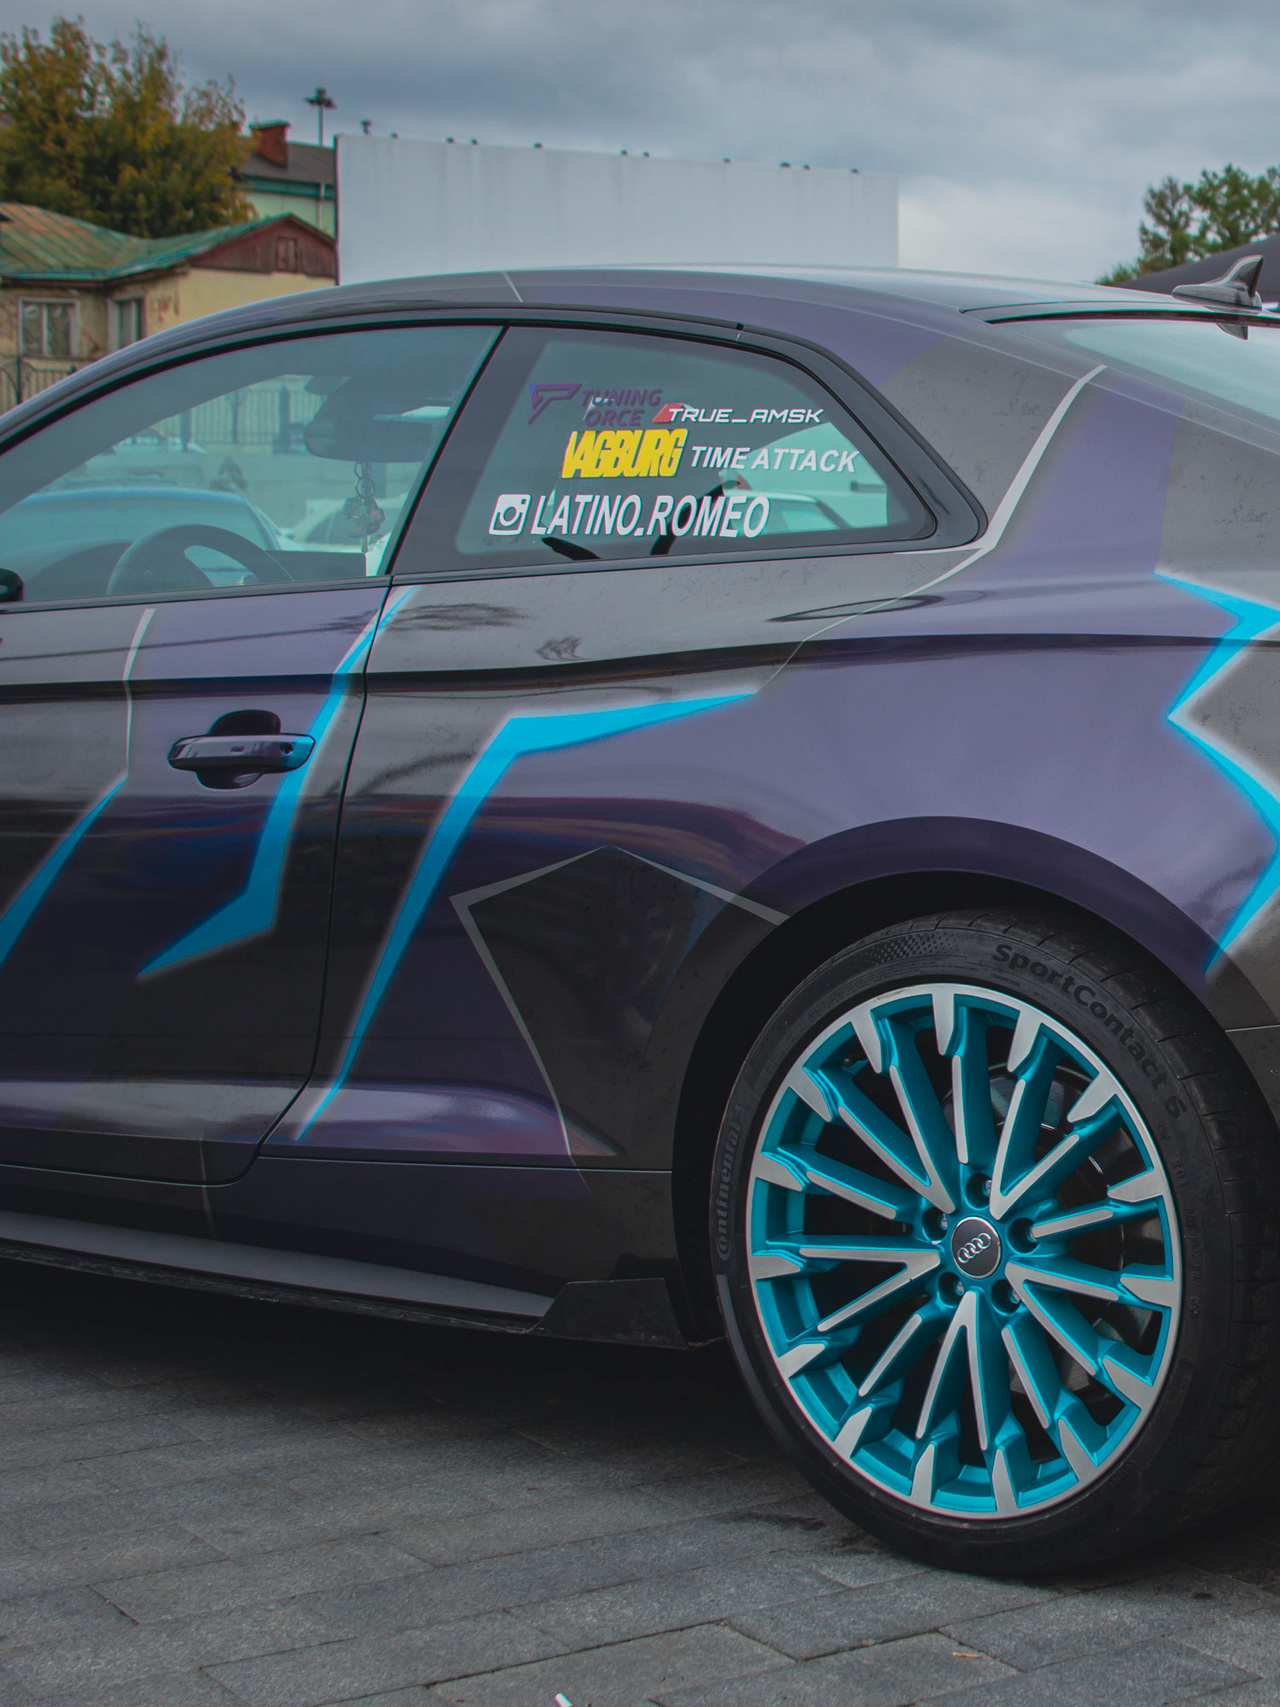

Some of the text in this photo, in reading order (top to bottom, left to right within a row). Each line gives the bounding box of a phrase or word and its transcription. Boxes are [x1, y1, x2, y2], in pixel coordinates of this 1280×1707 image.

[581, 388, 663, 407] TUNING
[667, 407, 824, 424] TRUE_AMSK
[690, 446, 859, 472] TIME ATTACK
[530, 494, 771, 538] LATINO.ROMEO
[992, 944, 1168, 1090] SportContact
[1165, 1096, 1188, 1119] 6
[716, 1121, 742, 1262] Continental
